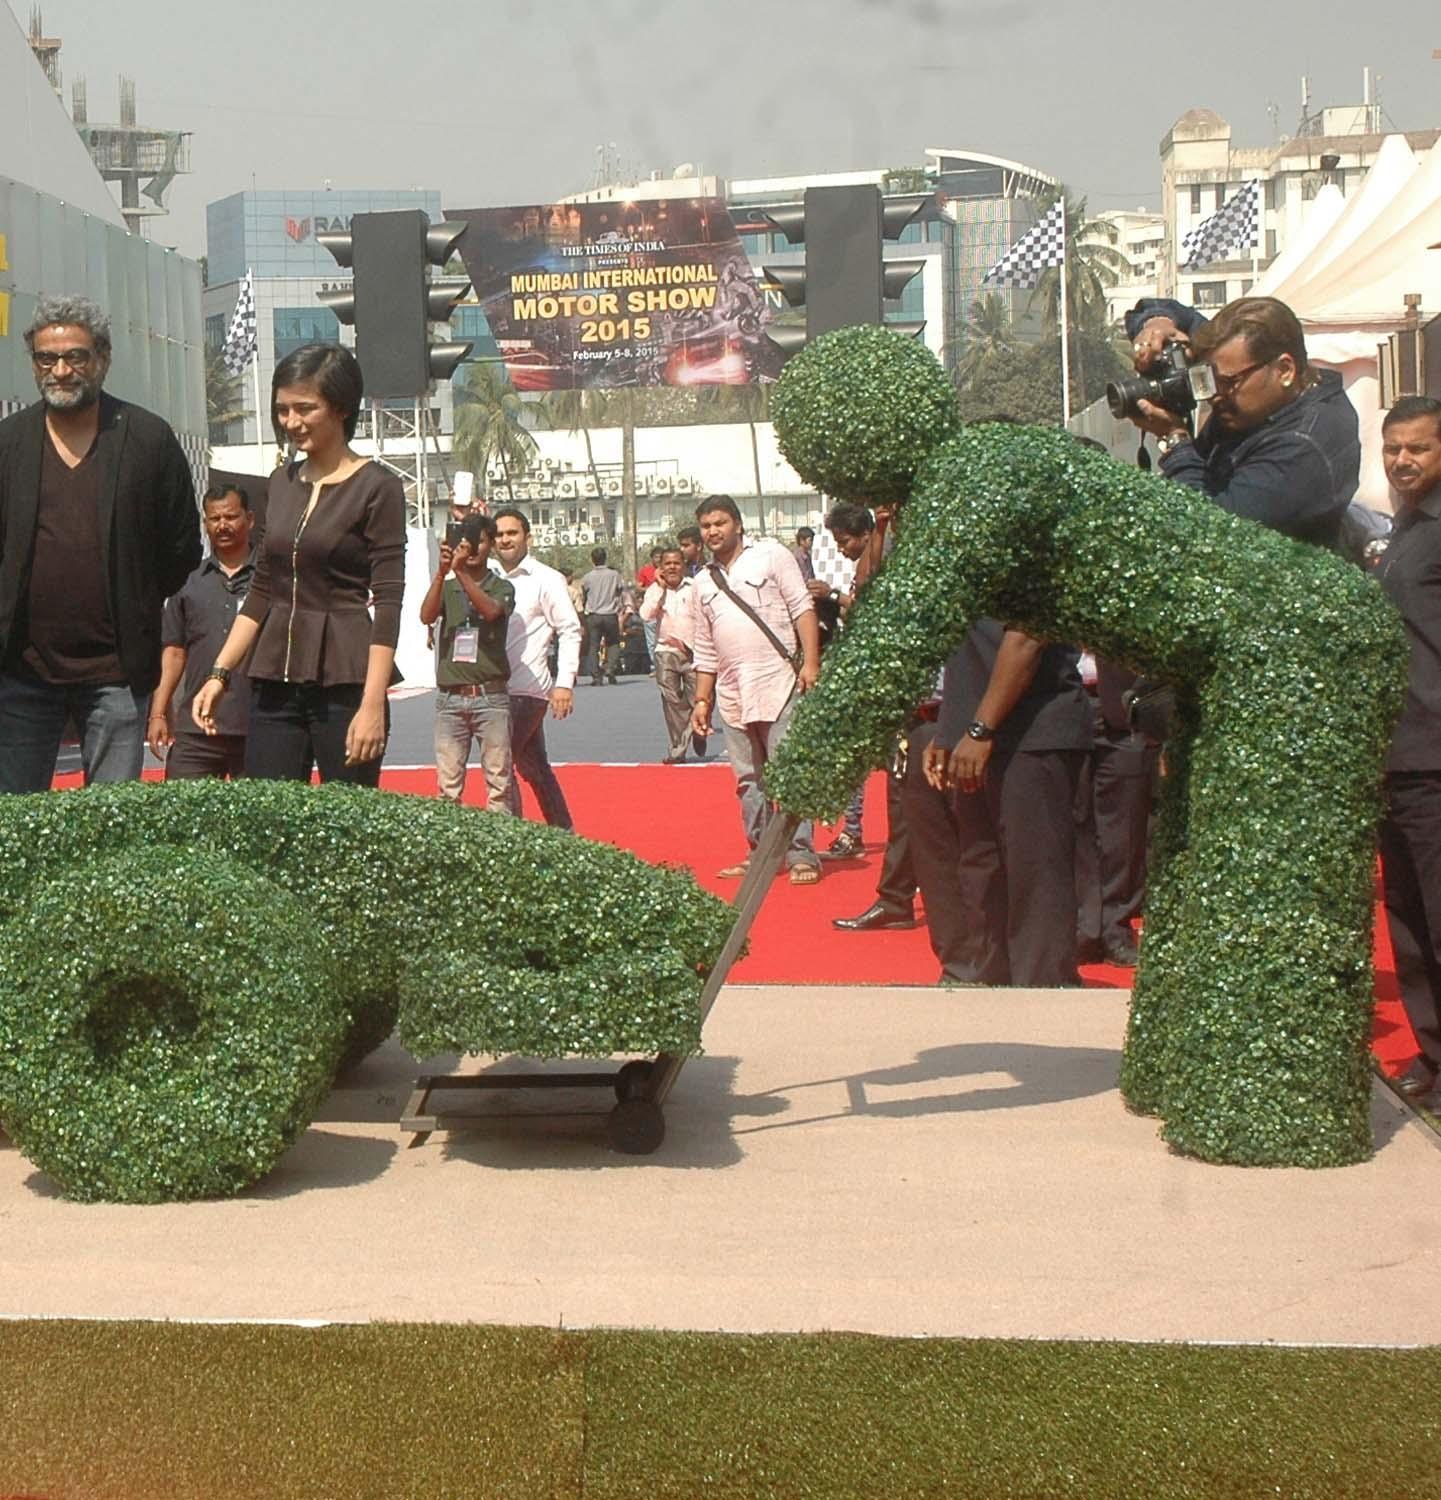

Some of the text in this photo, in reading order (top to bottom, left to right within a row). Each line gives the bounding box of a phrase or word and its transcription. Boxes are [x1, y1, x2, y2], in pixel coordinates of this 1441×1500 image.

[561, 241, 665, 257] THE TIMES OF INDIA
[511, 264, 718, 293] MUMBAI INTERNATIONAL
[513, 286, 717, 320] MOTOR SHOW
[581, 317, 651, 343] 2015
[573, 347, 658, 361] February 5-8, 2015
